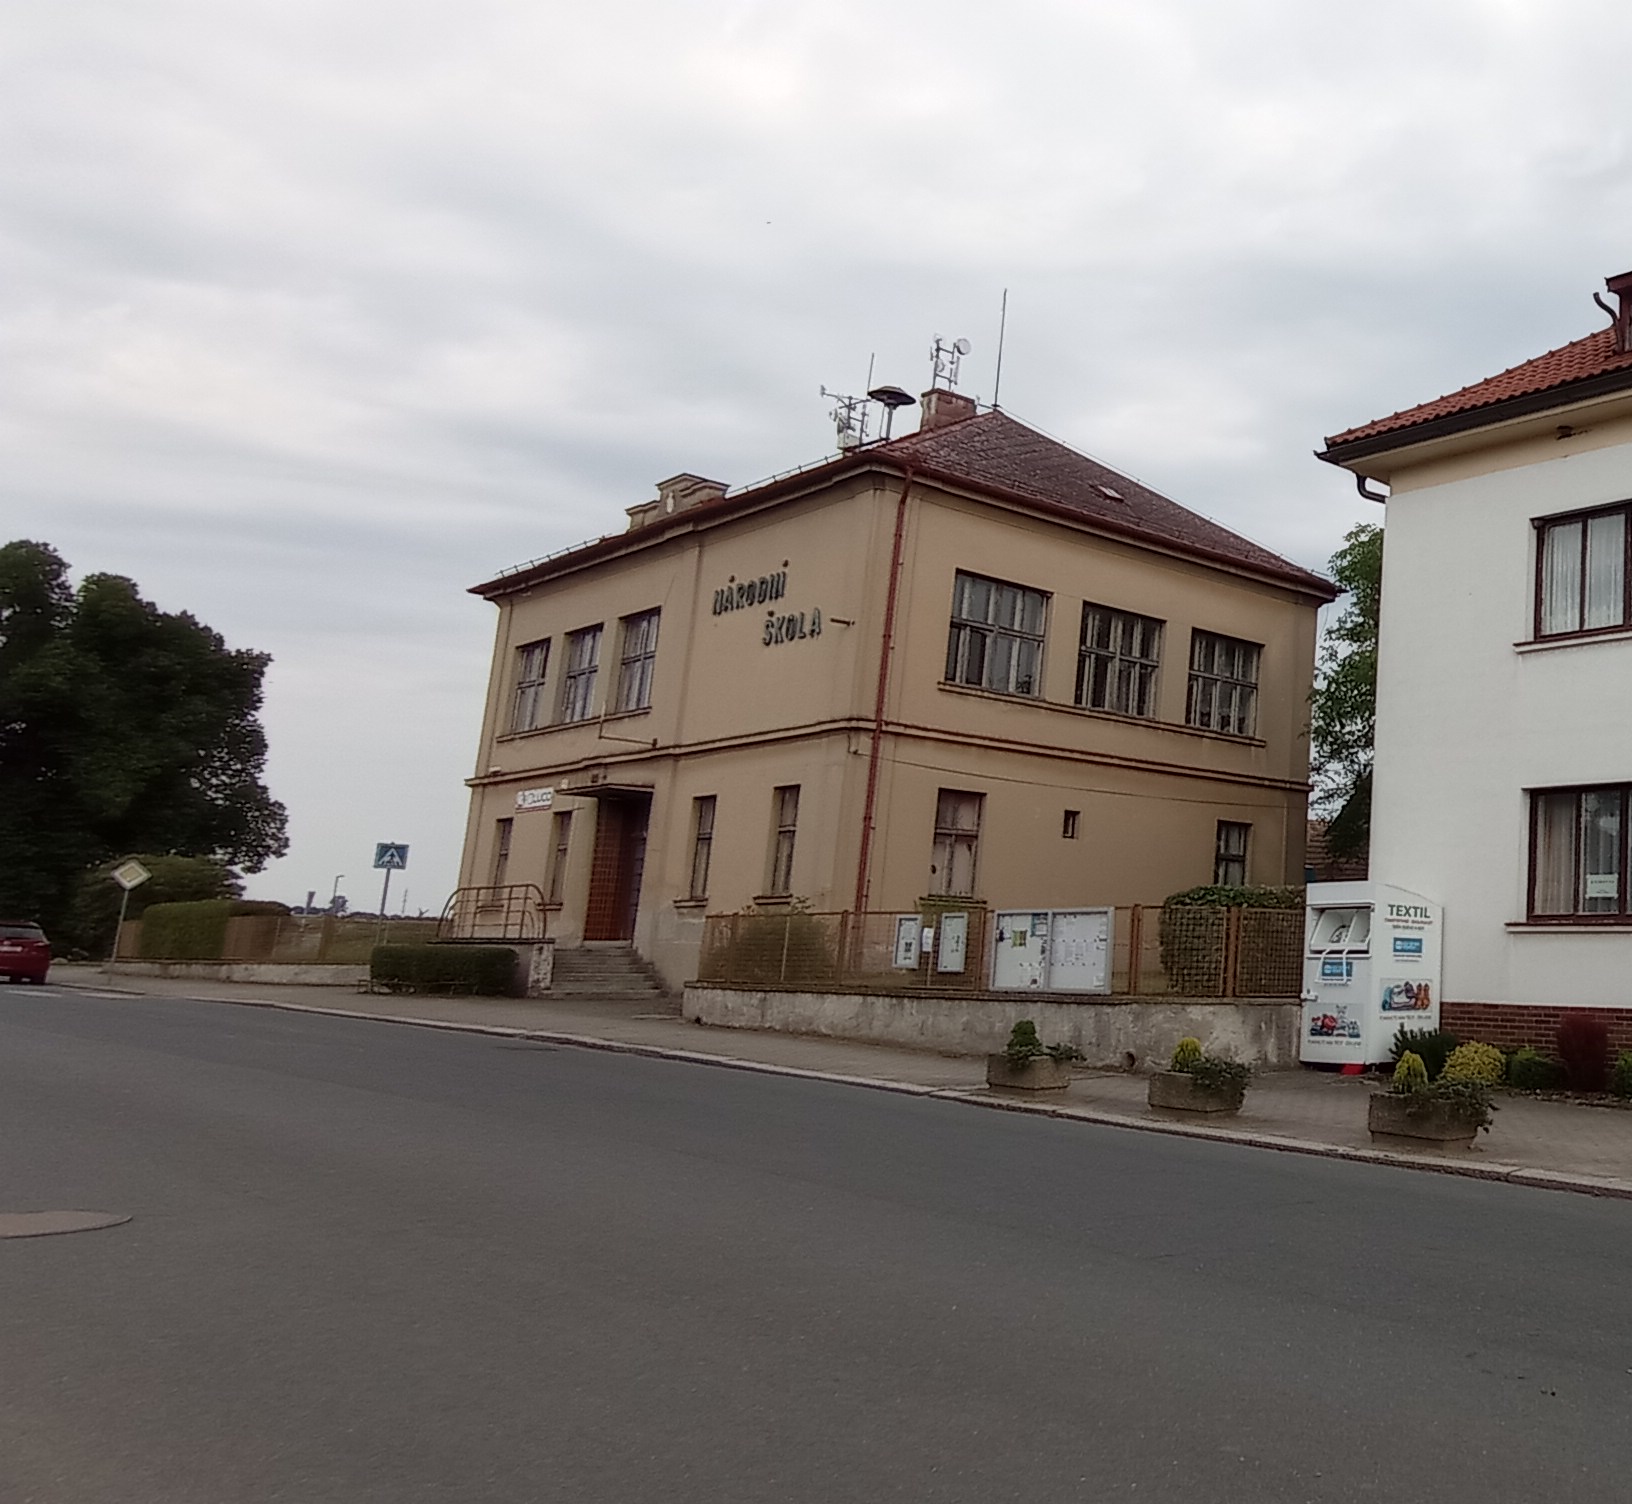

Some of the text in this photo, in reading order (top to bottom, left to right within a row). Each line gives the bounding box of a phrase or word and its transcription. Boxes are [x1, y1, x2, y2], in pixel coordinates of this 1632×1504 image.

[712, 559, 789, 616] NÁRODNÍ
[762, 607, 821, 647] ŠKOLA
[1387, 904, 1431, 918] TEXTIL
